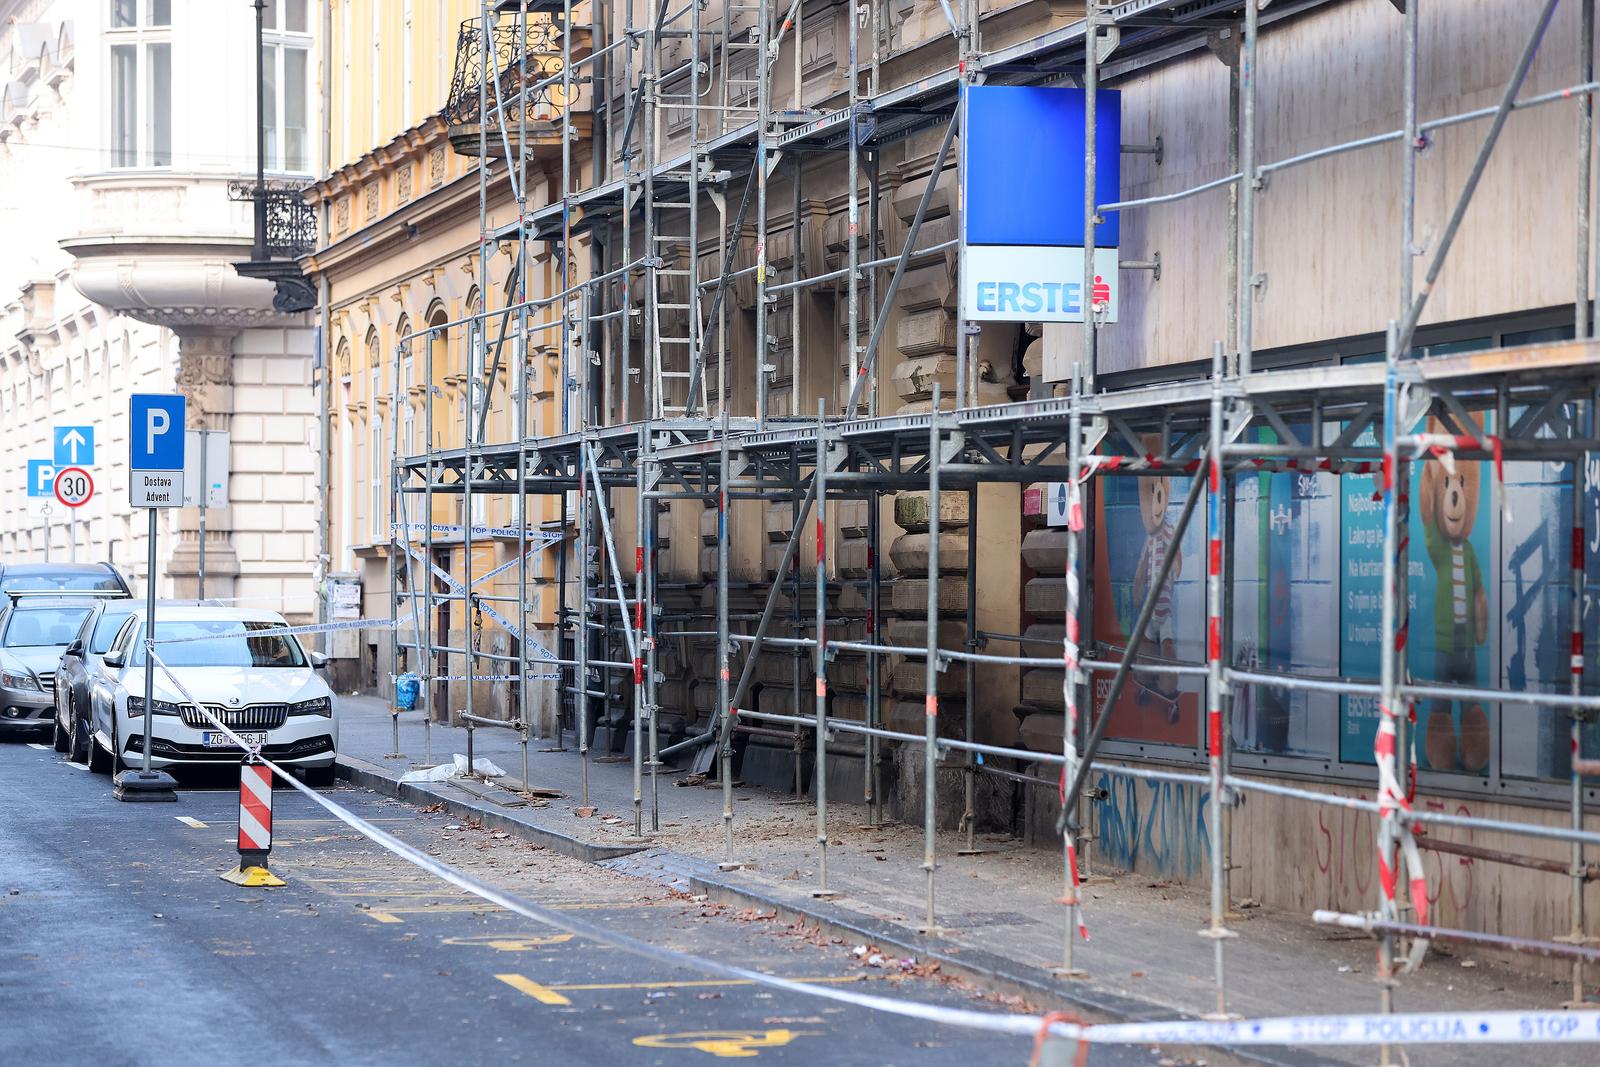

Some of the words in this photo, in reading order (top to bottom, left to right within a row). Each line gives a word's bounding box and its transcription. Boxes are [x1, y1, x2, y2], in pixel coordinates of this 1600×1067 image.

[977, 281, 1080, 313] ERSTE
[147, 408, 170, 454] P
[38, 465, 56, 490] P
[63, 477, 86, 497] 30
[144, 476, 172, 487] Dostava
[146, 494, 170, 502] Advent
[414, 523, 450, 532] POICIJA
[211, 735, 223, 744] ZG
[1291, 1017, 1348, 1040] STOP
[1363, 1016, 1466, 1041] POLICIJA
[1519, 1016, 1580, 1038] STOP
